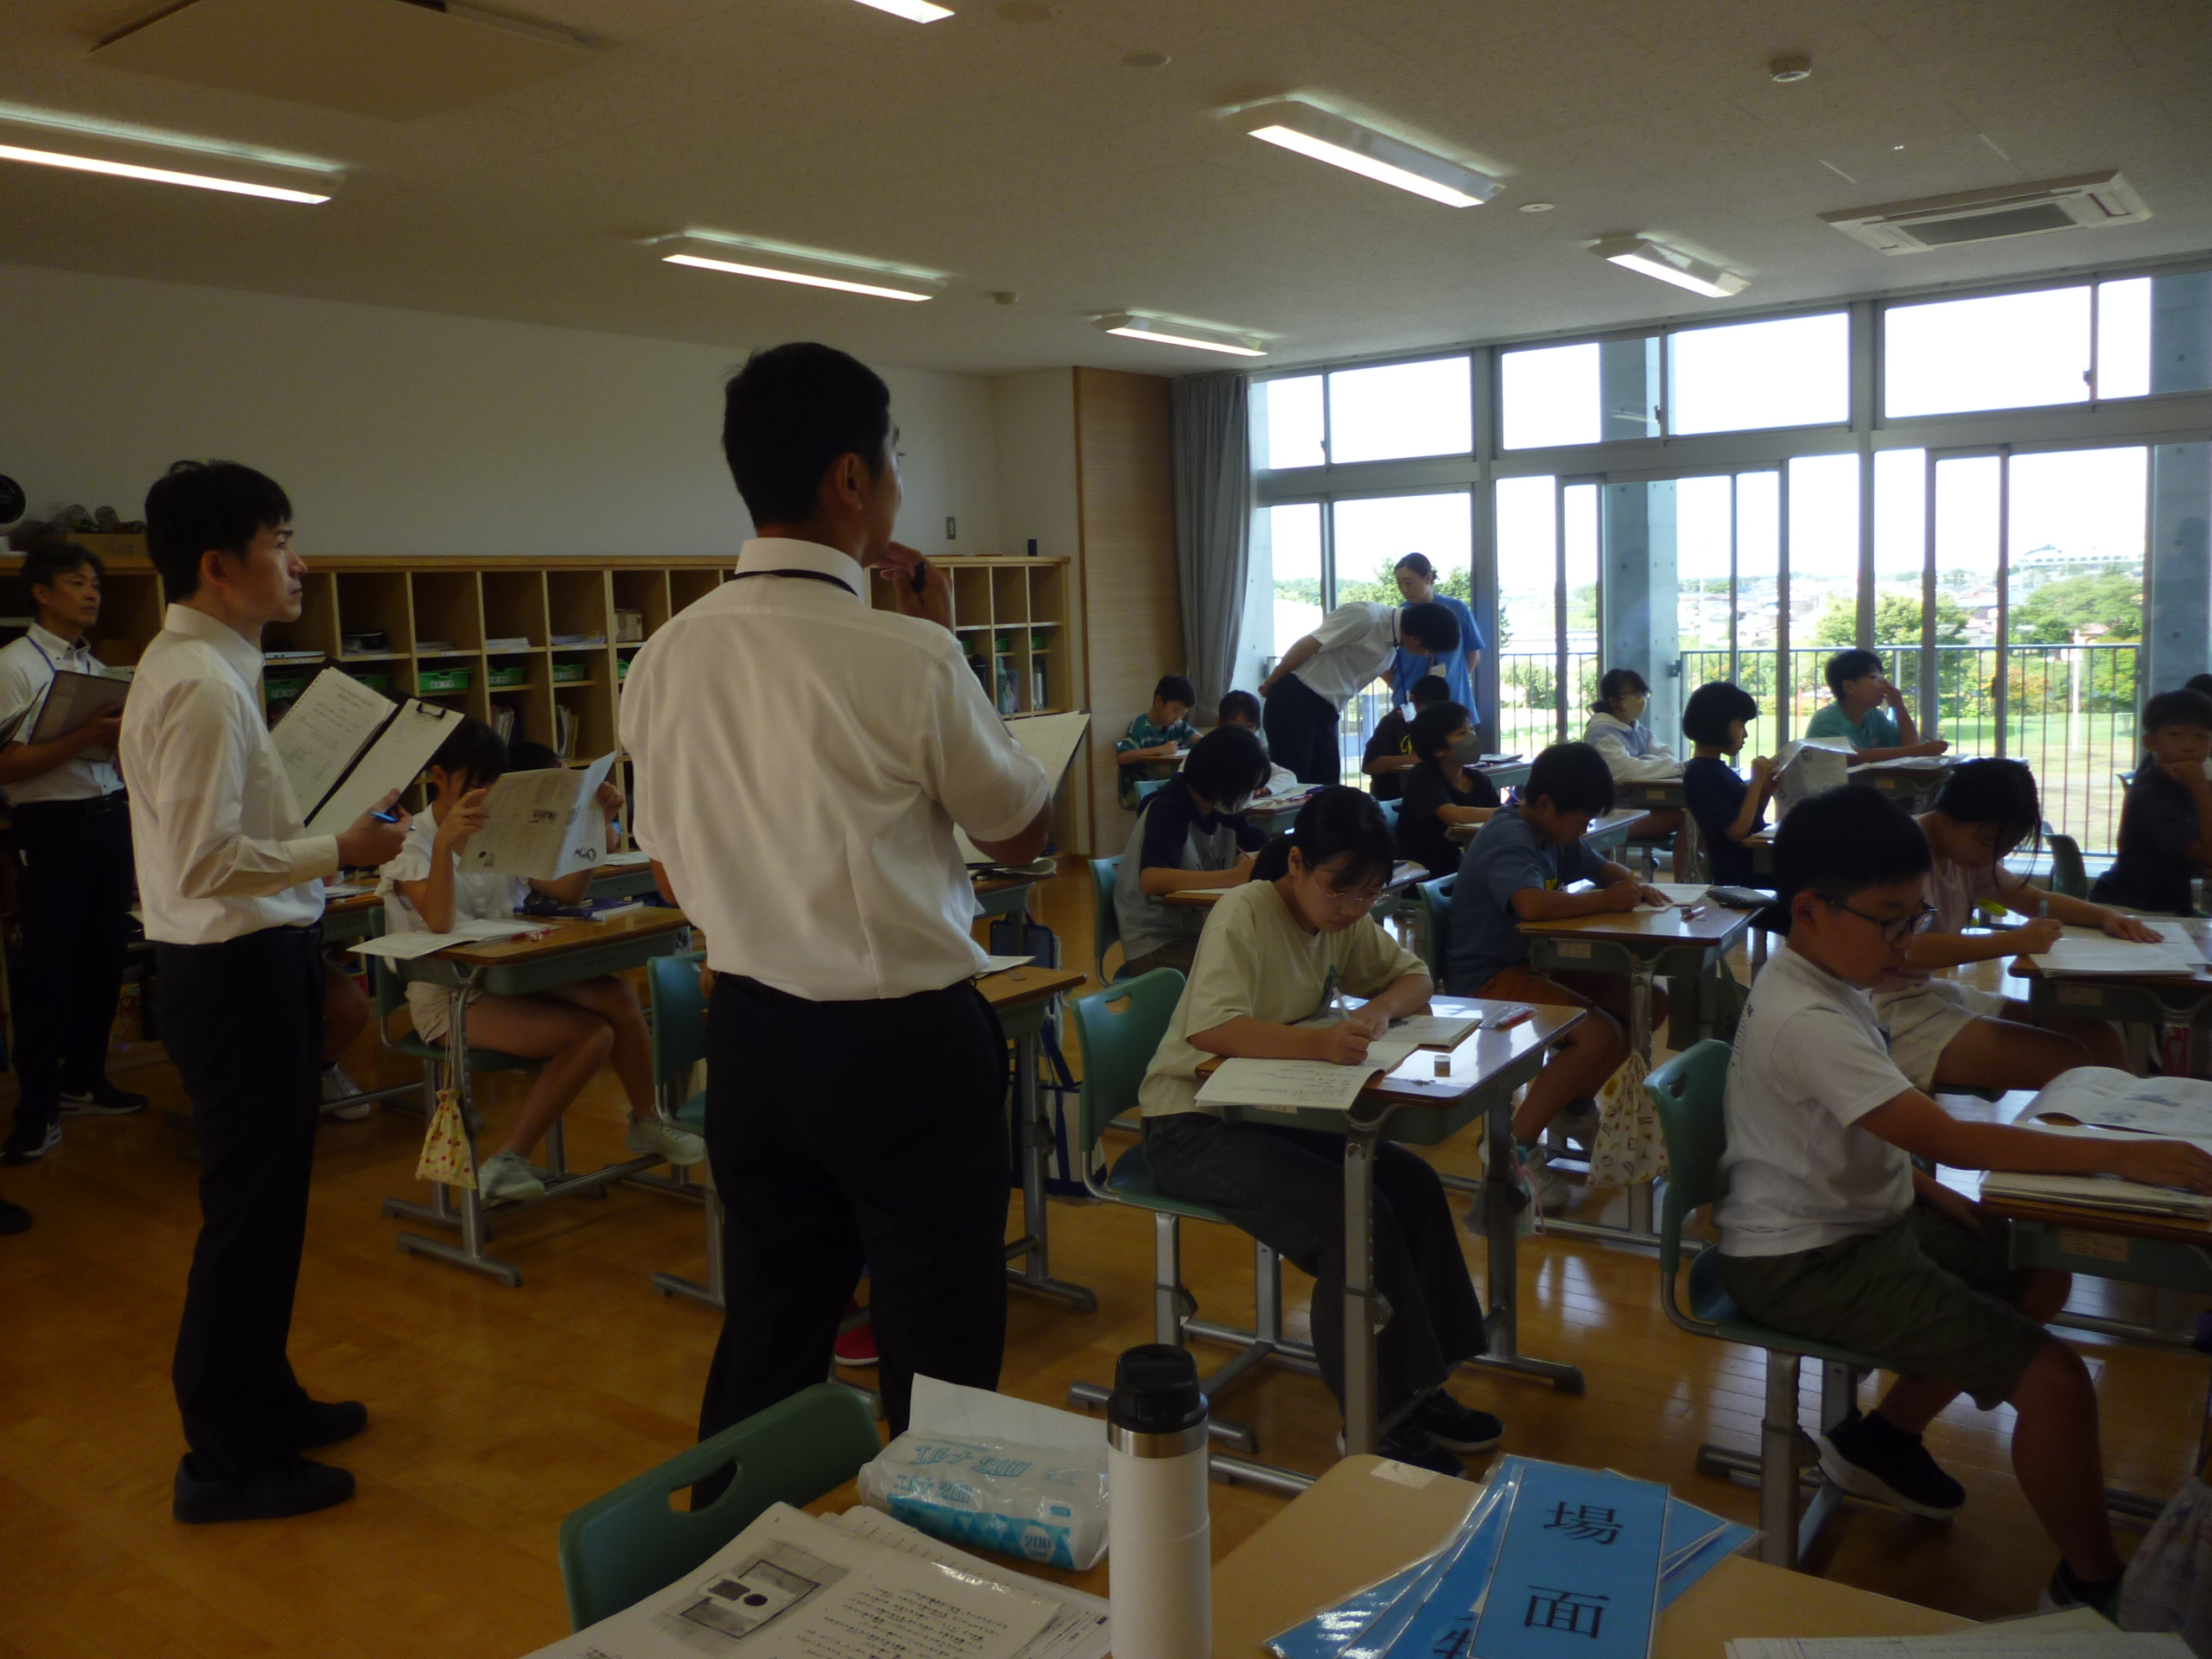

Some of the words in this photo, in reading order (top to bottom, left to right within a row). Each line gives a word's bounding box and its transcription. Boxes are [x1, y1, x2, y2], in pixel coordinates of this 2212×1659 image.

[971, 1456, 1033, 1478] 200
[938, 1480, 972, 1503] 200
[1024, 1535, 1052, 1549] 200
[1523, 1500, 1624, 1639] 場面
